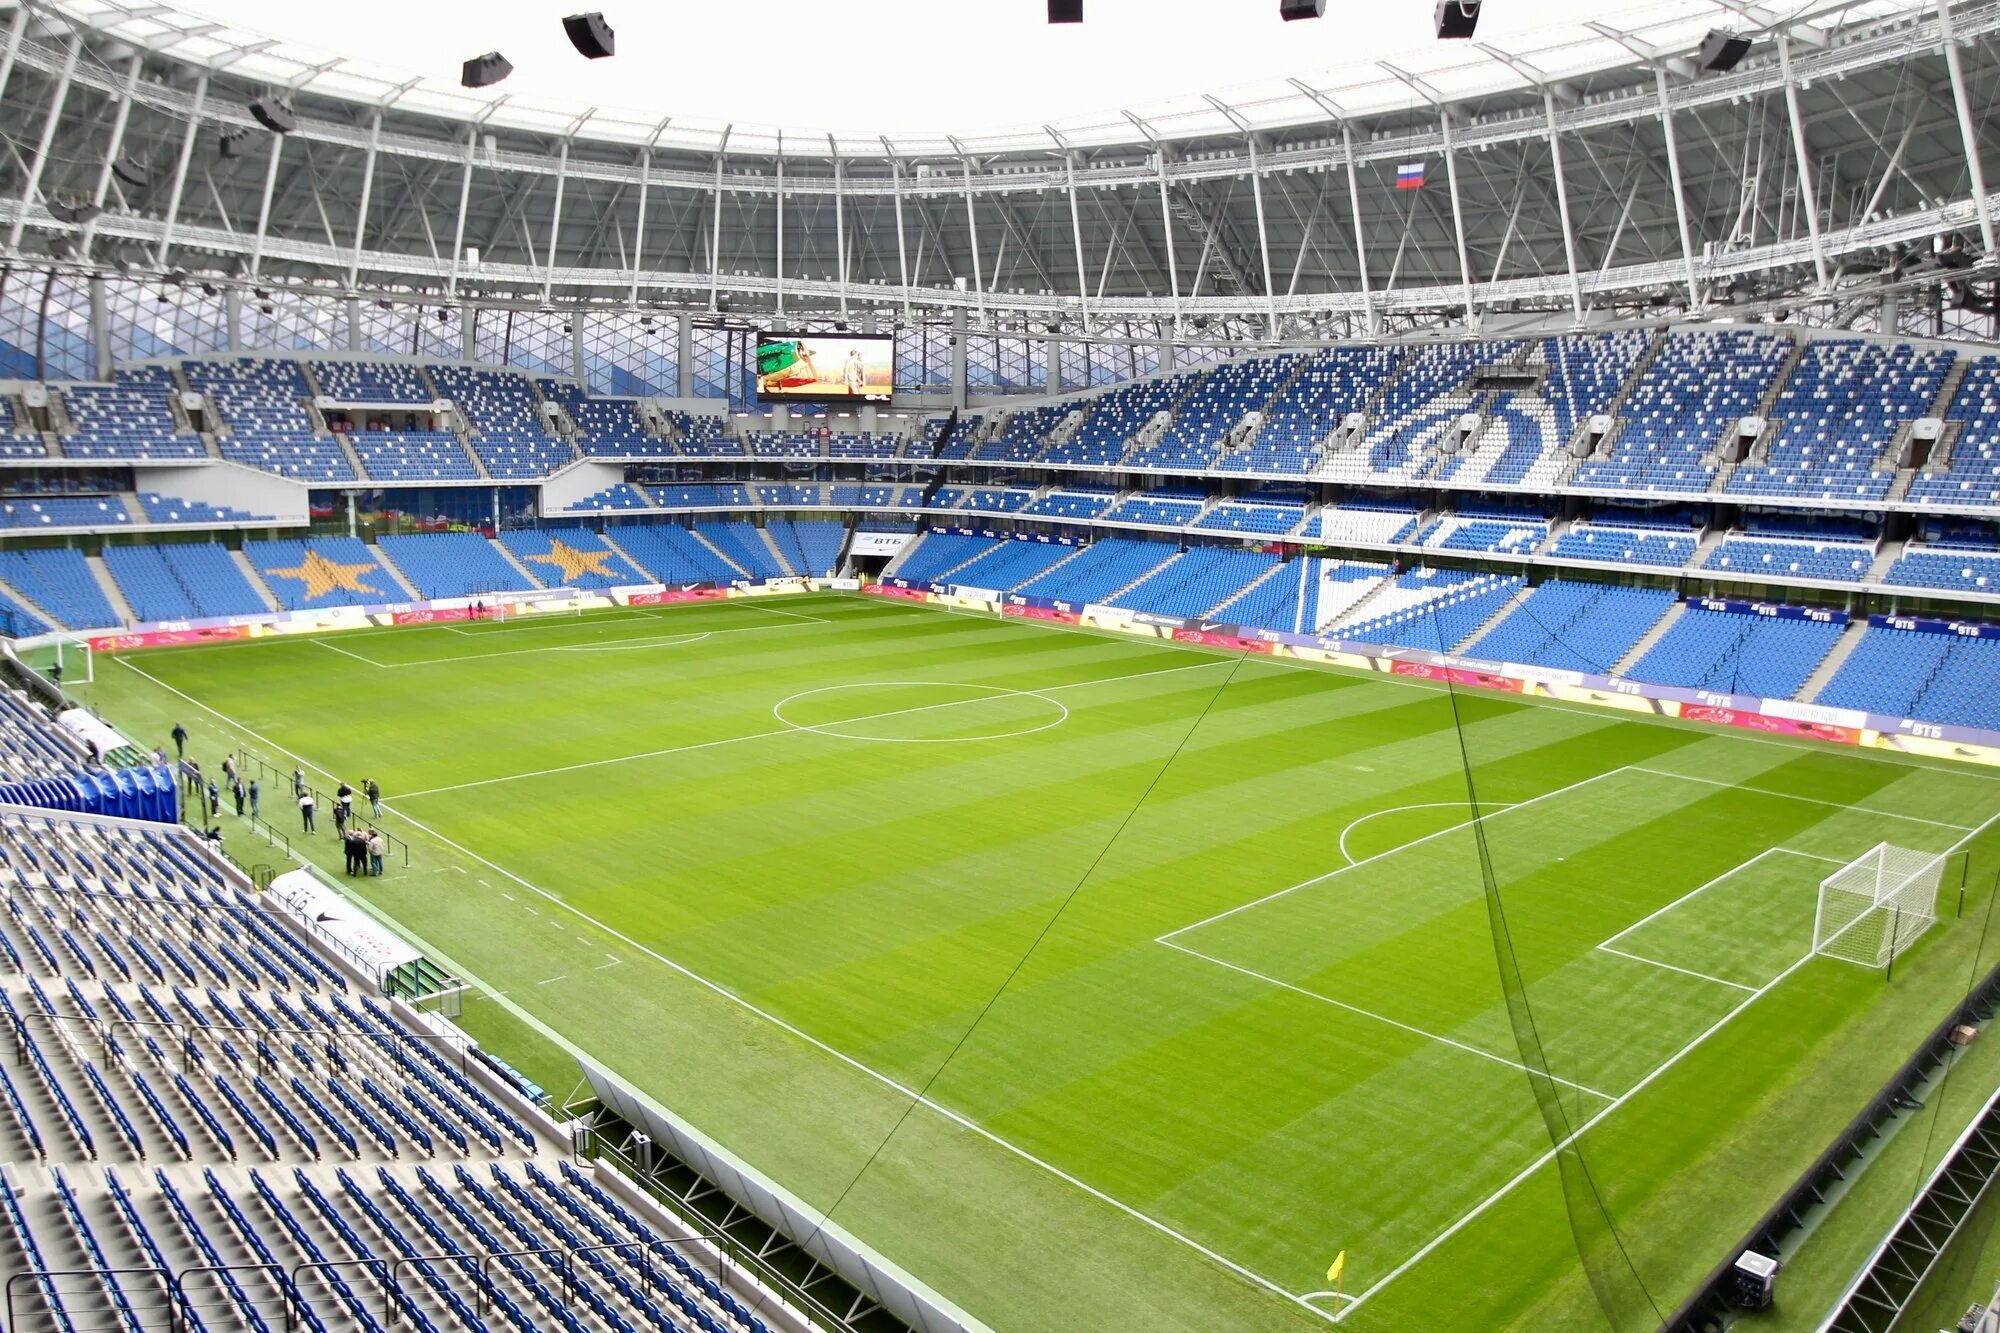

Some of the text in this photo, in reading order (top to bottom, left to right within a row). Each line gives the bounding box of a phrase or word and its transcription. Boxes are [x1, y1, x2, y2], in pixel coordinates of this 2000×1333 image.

[1708, 600, 1726, 612] ВТБ
[1758, 605, 1777, 617] ВТБ
[1811, 611, 1831, 622] ВТБ
[1895, 619, 1915, 630] ВТБ
[1958, 625, 1979, 636] ВТБ
[1263, 632, 1280, 642] ВТБ
[1323, 640, 1341, 651] ВТБ
[1617, 681, 1640, 694] ВТБ
[1706, 694, 1732, 708] ВТБ
[1912, 723, 1942, 738] ВТБ
